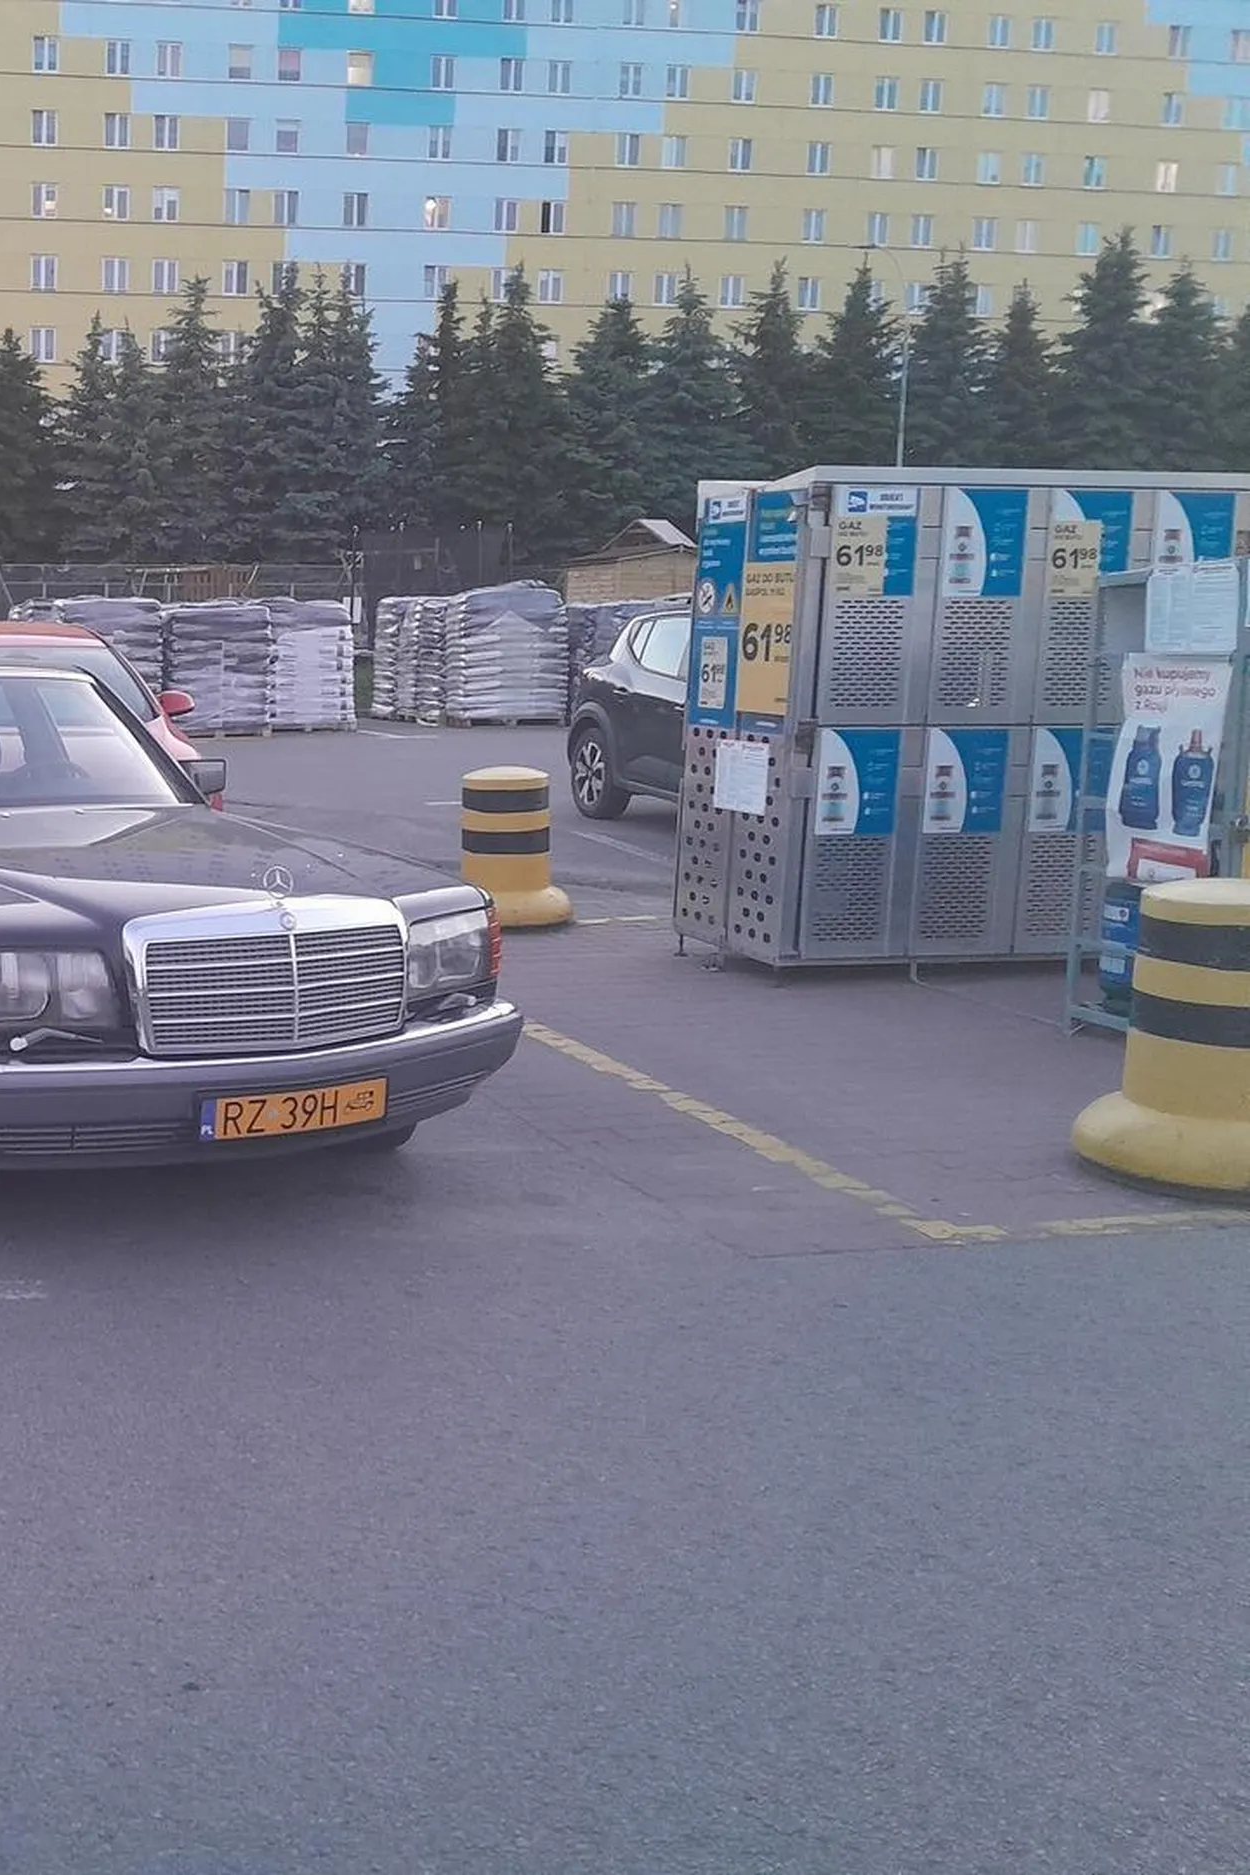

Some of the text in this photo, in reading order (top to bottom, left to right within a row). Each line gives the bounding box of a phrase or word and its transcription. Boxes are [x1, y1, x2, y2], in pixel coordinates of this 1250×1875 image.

[838, 521, 862, 530] GAZ
[1055, 524, 1078, 534] GAZ
[223, 1090, 339, 1136] RZ 39H
